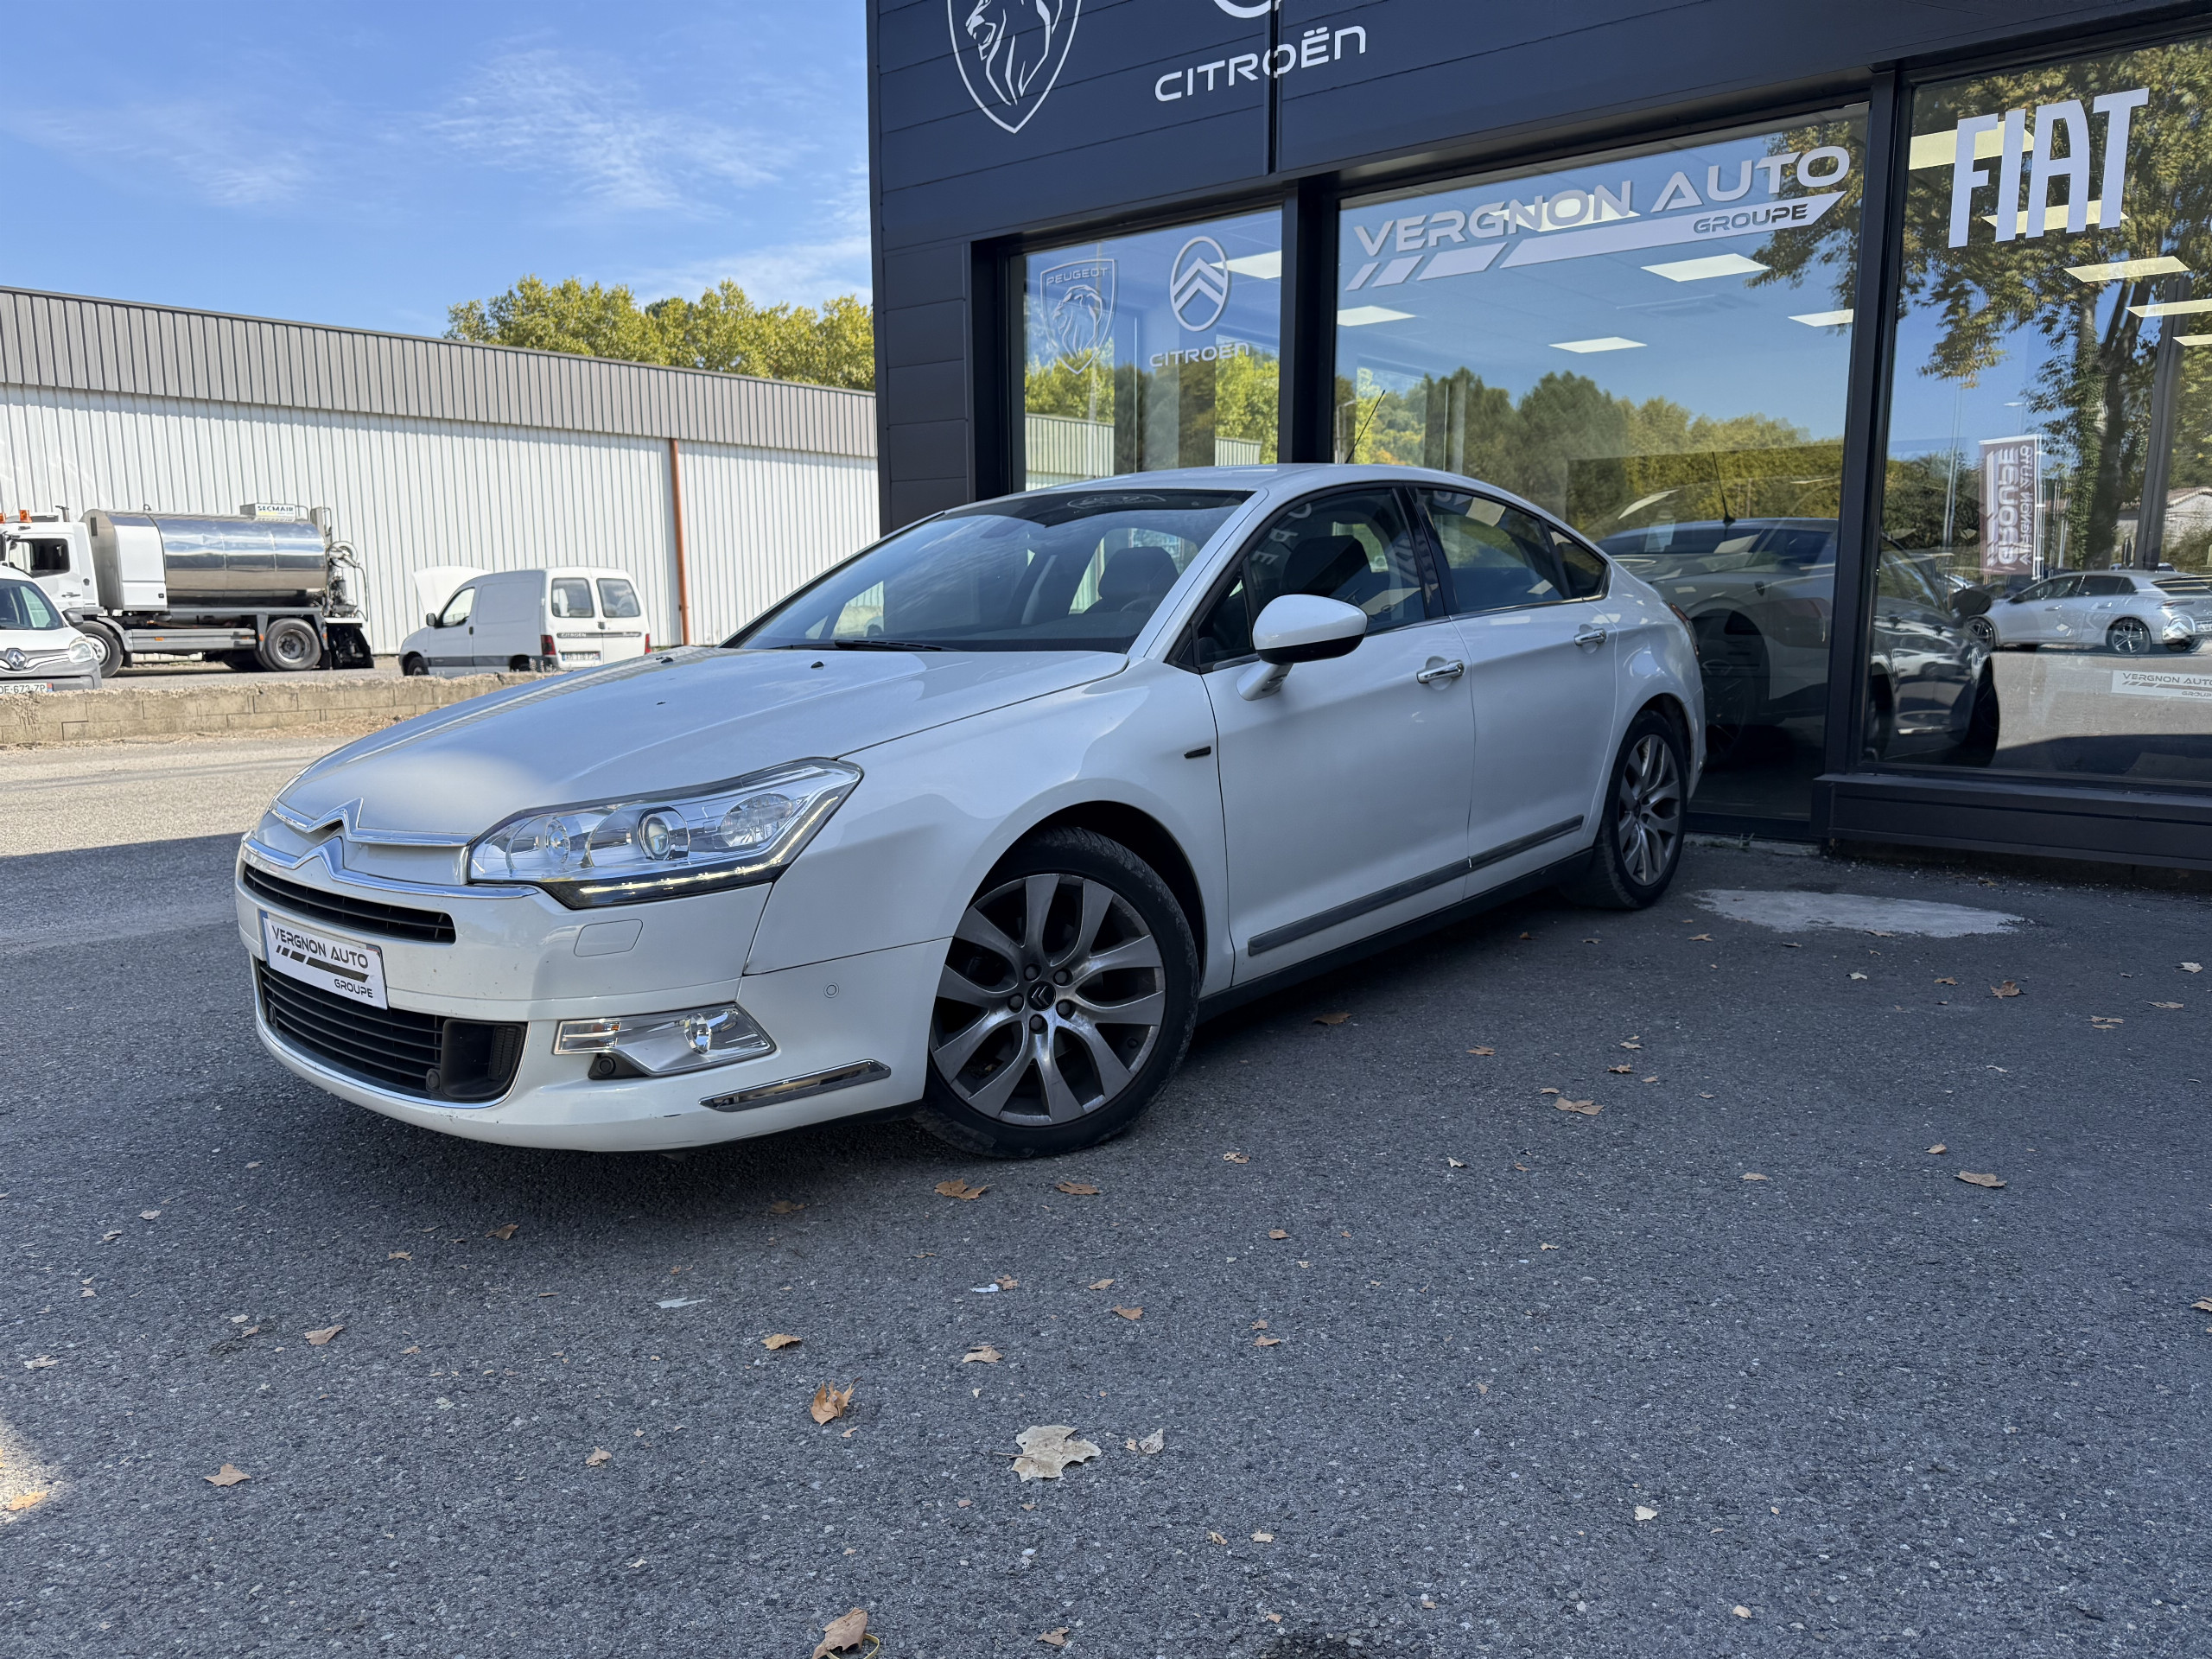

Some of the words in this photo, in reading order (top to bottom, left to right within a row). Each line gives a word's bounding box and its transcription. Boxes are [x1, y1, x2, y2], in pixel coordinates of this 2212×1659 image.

[1154, 25, 1367, 102] CITROËN
[1948, 87, 2150, 249] FIAT
[1354, 180, 1633, 257] VERGNON
[1649, 145, 1850, 213] AUTO
[1693, 202, 1809, 235] GROUPE
[1046, 267, 1109, 286] PEUGEOT
[2122, 673, 2181, 684] VERGNON
[271, 925, 327, 958] VERGNON
[330, 945, 369, 969] AUTO
[334, 978, 374, 999] GROUPE
